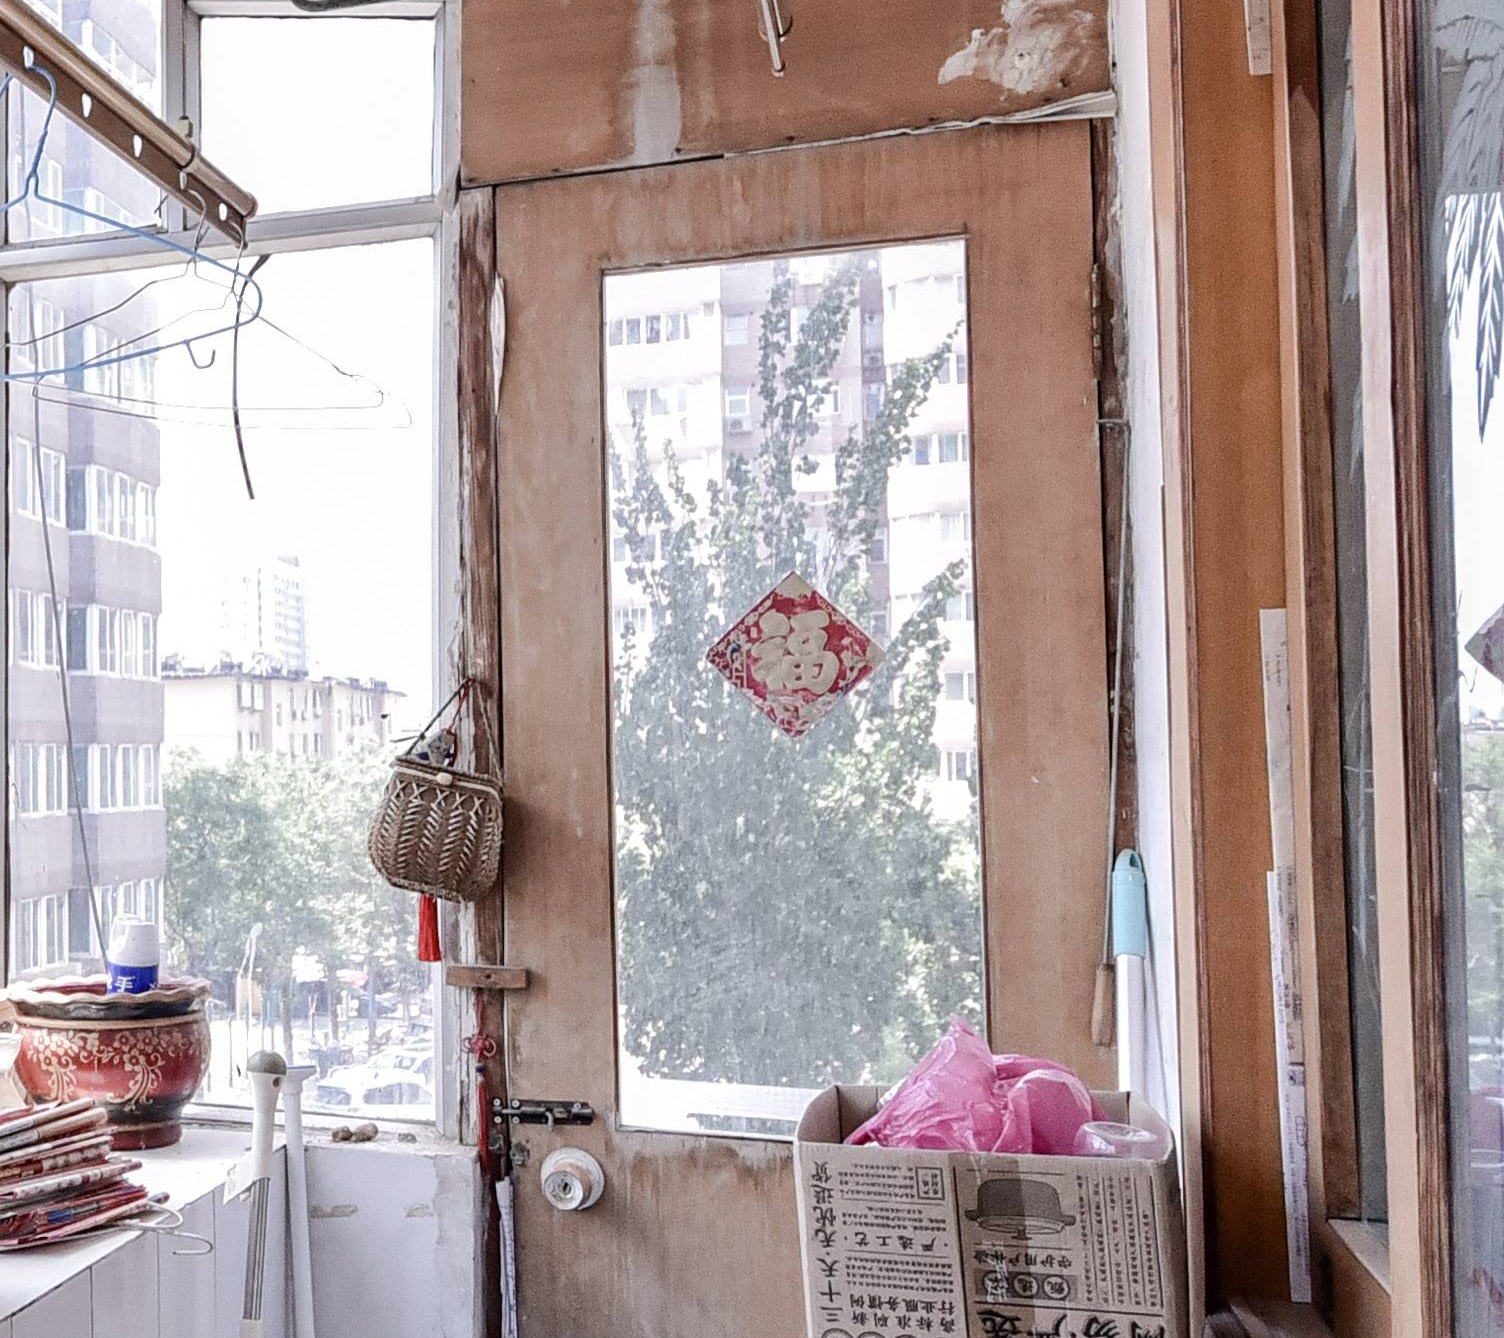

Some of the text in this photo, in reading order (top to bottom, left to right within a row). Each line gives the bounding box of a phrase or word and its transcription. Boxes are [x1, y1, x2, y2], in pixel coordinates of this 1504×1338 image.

[850, 1294, 955, 1316] 行业服务惯例
[852, 1311, 955, 1333] 高标准刷新
